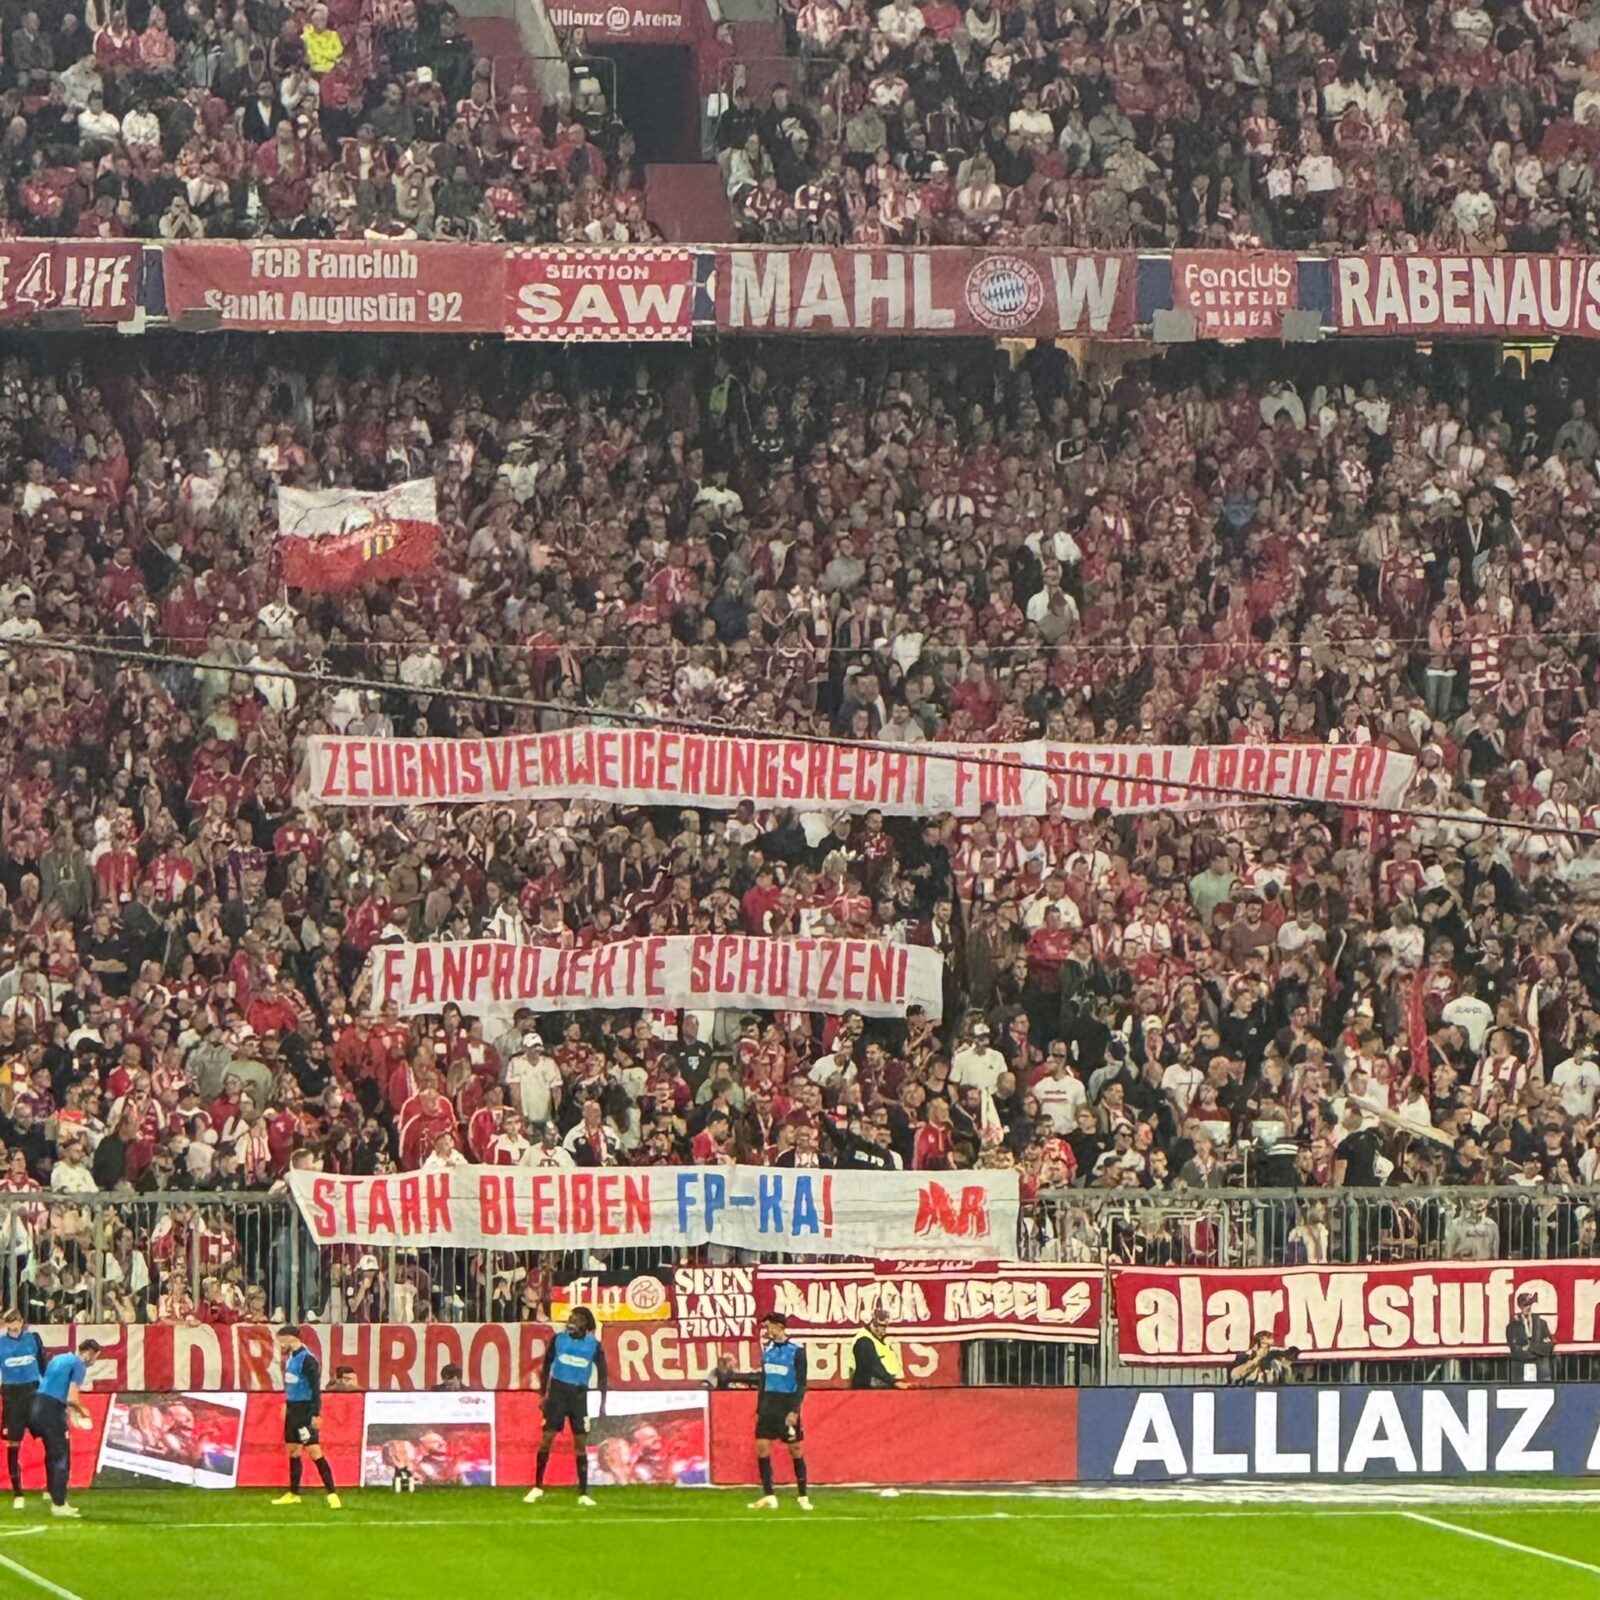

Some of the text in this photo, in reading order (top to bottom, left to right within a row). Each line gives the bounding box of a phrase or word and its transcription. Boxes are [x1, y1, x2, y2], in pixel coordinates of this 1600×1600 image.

[632, 10, 682, 27] Arena
[251, 249, 418, 279] FCB Fanclub
[546, 264, 649, 281] SEKTION
[204, 288, 285, 321] Sankt
[290, 292, 416, 324] Augustin
[517, 283, 686, 324] SAW
[729, 252, 955, 330] MAHL
[321, 731, 927, 807] ZEUGNISVERWEIGERUNGSRECHT
[383, 938, 668, 1005] FANPROJEKTE
[312, 1173, 453, 1237] STARK
[479, 1174, 652, 1236] BLEIBEN
[677, 1173, 833, 1239] FP-KA!
[674, 1267, 755, 1295] SEEN
[676, 1294, 757, 1318] LAND
[943, 1280, 1092, 1324] REBELS
[679, 1318, 757, 1339] FRONT
[1113, 1389, 1555, 1475] ALLIANZ
